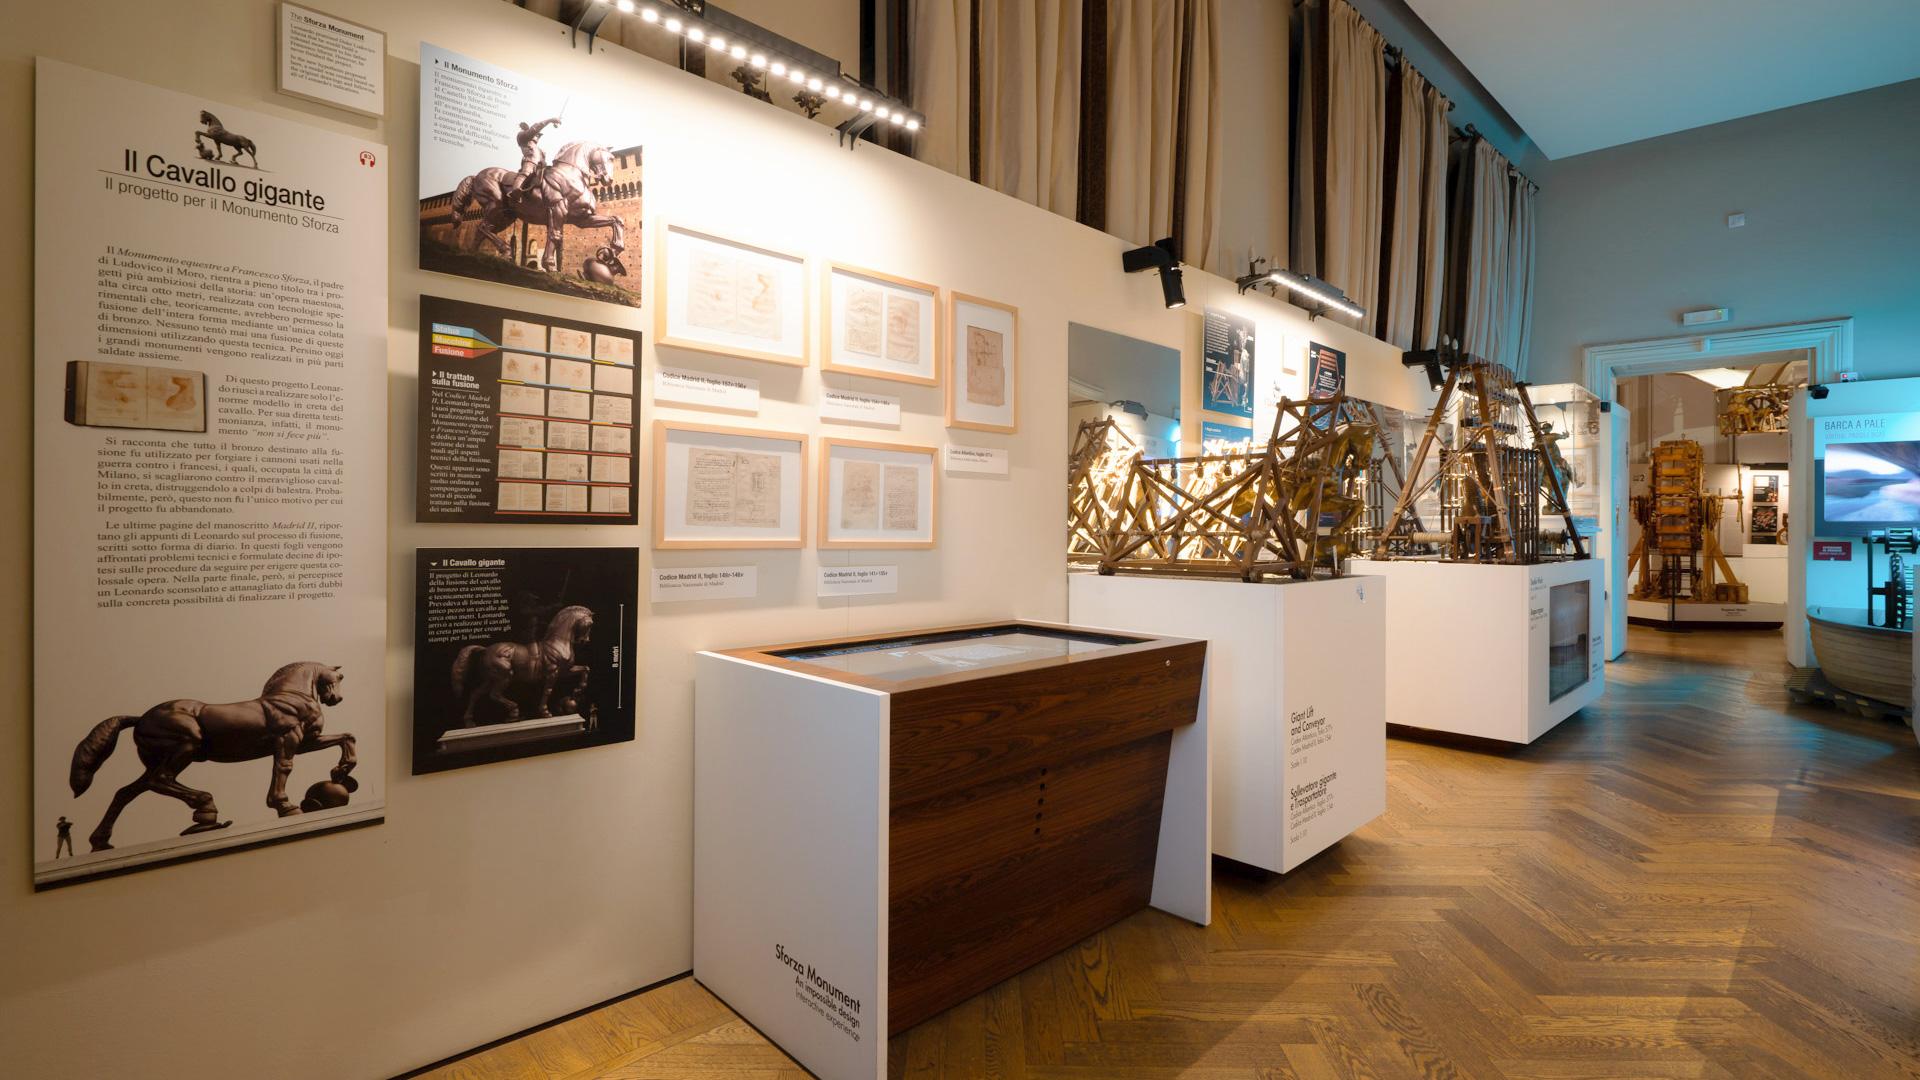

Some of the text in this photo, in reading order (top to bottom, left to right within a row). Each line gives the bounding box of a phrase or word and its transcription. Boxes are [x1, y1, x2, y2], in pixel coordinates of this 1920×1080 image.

[290, 12, 365, 40] The Sforza Monument
[451, 63, 494, 83] Monumento
[495, 78, 518, 91] Sforza
[124, 149, 325, 211] Il Cavallo gigante
[105, 175, 340, 234] Il progetto per il Monumento Sforza
[97, 278, 344, 320] alta circa otto metri, realizzata con tecnologie spe-
[97, 288, 344, 329] rimentali che, teoricamente, avrebbero permesso la
[97, 310, 108, 320] di
[112, 312, 151, 325] bronzo.
[156, 318, 199, 331] Nessuno
[202, 324, 226, 334] tentò
[230, 328, 247, 337] mai
[270, 332, 302, 343] fusione
[305, 336, 313, 345] di
[316, 340, 343, 348] queste
[434, 346, 464, 356] Fusione
[431, 377, 479, 388] sulla fusione
[446, 372, 474, 381] trattato
[682, 374, 700, 382] Madrid
[218, 396, 248, 404] norme
[252, 398, 290, 408] modello
[294, 400, 302, 408] in
[330, 403, 343, 412] del
[440, 398, 469, 406] Leonardo
[438, 412, 478, 421] realizzazione
[1825, 420, 1853, 430] BARCA
[1856, 420, 1861, 428] A
[97, 446, 126, 456] sione
[130, 448, 141, 457] fu
[144, 449, 192, 459] utilizzato
[195, 453, 211, 462] per
[214, 452, 252, 463] forgiare
[254, 454, 258, 462] i
[322, 457, 343, 465] nella
[97, 469, 140, 480] Milano,
[142, 470, 151, 479] si
[154, 472, 212, 482] scagliarono
[248, 474, 254, 482] il
[257, 475, 315, 486] meraviglioso
[123, 531, 137, 542] gli
[140, 531, 178, 542] appunti
[180, 531, 190, 539] di
[193, 531, 239, 539] Leonardo
[241, 531, 255, 539] sul
[257, 533, 296, 541] processo
[309, 531, 343, 540] fusione,
[97, 570, 343, 586] lossale opera. Nella parte finale, però, si percepisce
[1291, 710, 1305, 723] Giant
[1291, 717, 1326, 735] and Conveyor
[1291, 772, 1336, 799] Sollevatore gigante
[776, 944, 860, 1014] Sforza Monument
[796, 975, 860, 1028] An impossible design
[826, 1012, 860, 1042] experience
